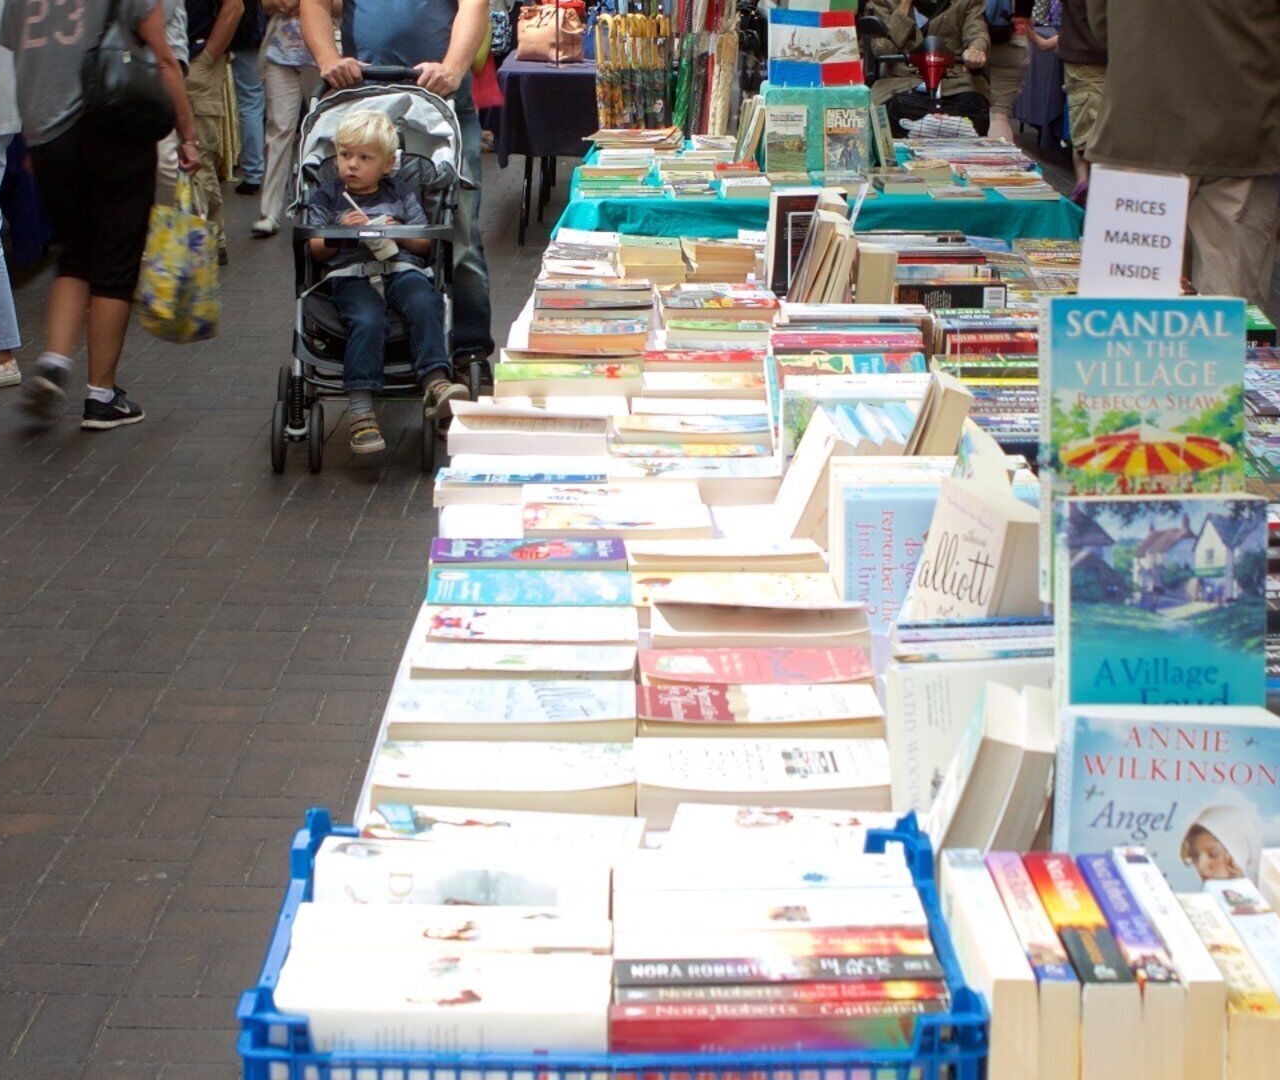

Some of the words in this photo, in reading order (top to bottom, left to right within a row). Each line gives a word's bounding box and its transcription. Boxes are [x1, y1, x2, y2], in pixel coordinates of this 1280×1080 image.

[826, 108, 860, 119] NEVIL
[826, 118, 865, 128] SHUTE
[1114, 197, 1167, 216] PRICES
[1104, 229, 1171, 249] MARKED
[1109, 263, 1160, 281] INSIDE
[1066, 309, 1231, 338] SCANDAL
[1107, 340, 1133, 358] IN
[1142, 340, 1188, 358] THE
[1075, 360, 1218, 387] VILLAGE
[855, 522, 877, 560] first
[881, 509, 898, 592] remember
[904, 539, 923, 557] do
[918, 531, 994, 607] alliott
[881, 599, 901, 625] the
[1094, 659, 1117, 688] A
[1120, 657, 1219, 691] Village
[902, 677, 919, 736] CATHY
[1124, 725, 1231, 753] ANNIE
[1083, 754, 1280, 787] WILKINSON
[1088, 799, 1178, 842] Angel
[630, 963, 683, 979] NORA
[687, 961, 769, 979] ROBERT
[659, 987, 705, 1000] Nora
[710, 986, 783, 999] Roberts
[654, 1004, 708, 1017] Nora
[716, 1003, 799, 1016] Roberts
[820, 1002, 925, 1017] Captivated
